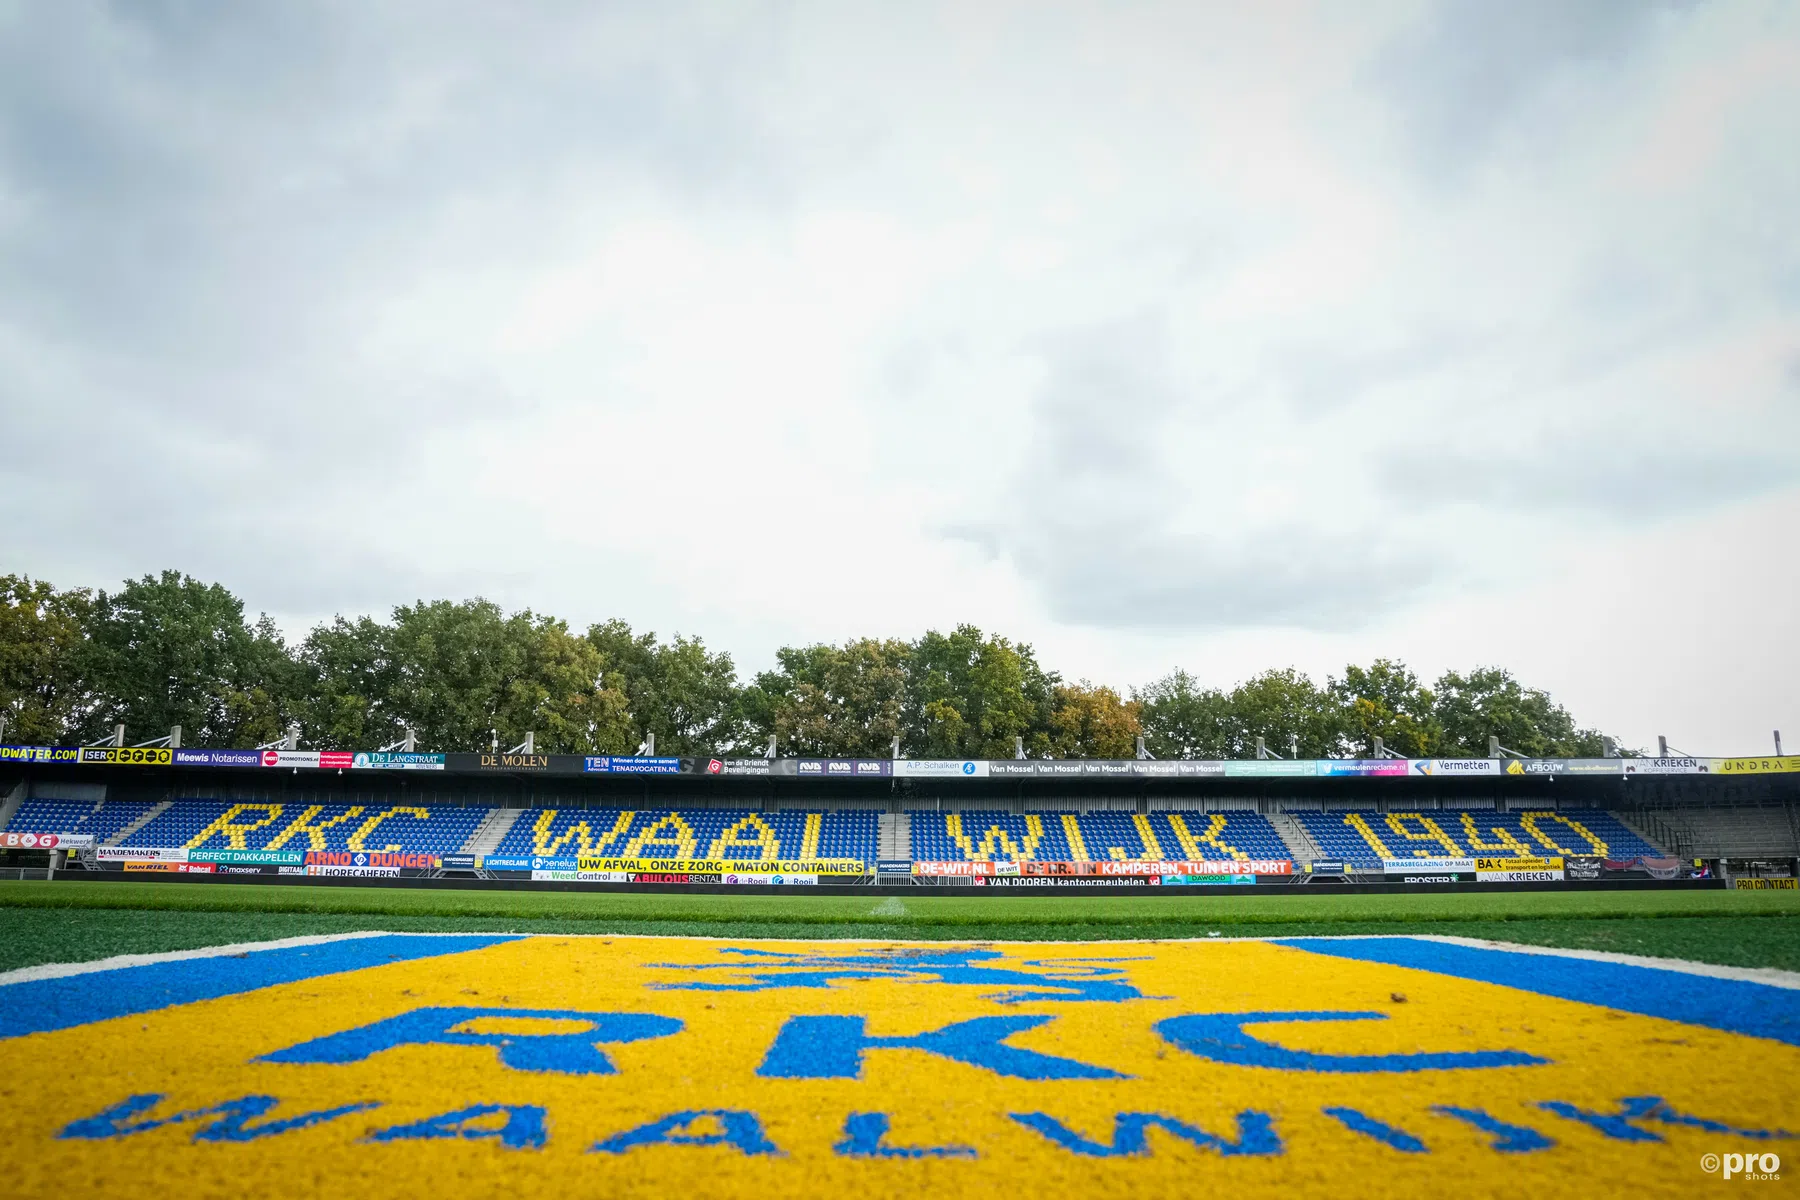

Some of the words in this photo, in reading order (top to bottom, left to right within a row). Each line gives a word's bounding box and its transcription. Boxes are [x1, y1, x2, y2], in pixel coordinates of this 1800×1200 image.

[0, 748, 77, 760] DWATER.COM
[177, 752, 209, 762] Meewis
[212, 753, 257, 764] Notarissen
[481, 755, 498, 766] DE
[502, 755, 548, 767] MOLEN
[586, 757, 609, 767] TEN
[1438, 760, 1490, 770] Vermetten
[990, 764, 1005, 773] Van
[1007, 764, 1034, 773] Mossel
[1038, 764, 1052, 773] Van
[1054, 764, 1082, 773] Mossel
[1085, 764, 1099, 773] Van
[1102, 764, 1129, 773] Mossel
[1133, 764, 1147, 773] Van
[1149, 764, 1176, 773] Mossel
[1180, 764, 1194, 773] Van
[1196, 764, 1223, 773] Mossel
[183, 803, 430, 853] RKC
[1343, 811, 1610, 858] 1940
[99, 849, 161, 857] MANDEMAKERS
[190, 852, 232, 861] PERFECT
[234, 853, 301, 862] DAKKAPELLEN
[304, 852, 352, 866] ARNO
[486, 859, 529, 867] LICHTRECLAME
[543, 857, 577, 867] benelux
[188, 865, 211, 873] Bobcat
[229, 866, 261, 874] maxserv
[579, 859, 600, 869] UW
[604, 860, 646, 871] AFVAL,
[651, 861, 685, 870] ONZE
[688, 862, 723, 871] ZORG
[733, 862, 779, 872] MATON
[783, 862, 863, 872] CONTAINERS
[920, 863, 989, 874] DE-WIT.NL
[1026, 863, 1044, 874] DE
[1083, 863, 1097, 874] IN
[1102, 862, 1182, 875] KAMPEREN,
[1184, 862, 1220, 874] TUIN
[1221, 862, 1241, 874] EN
[1242, 862, 1287, 874] SPORT
[989, 878, 1010, 886] VAN
[1012, 878, 1054, 886] DOOREN
[1057, 877, 1145, 886] kantoormeubelen
[1736, 879, 1753, 890] PRO
[1755, 879, 1795, 890] CONTACT
[250, 1006, 1555, 1080] RKC
